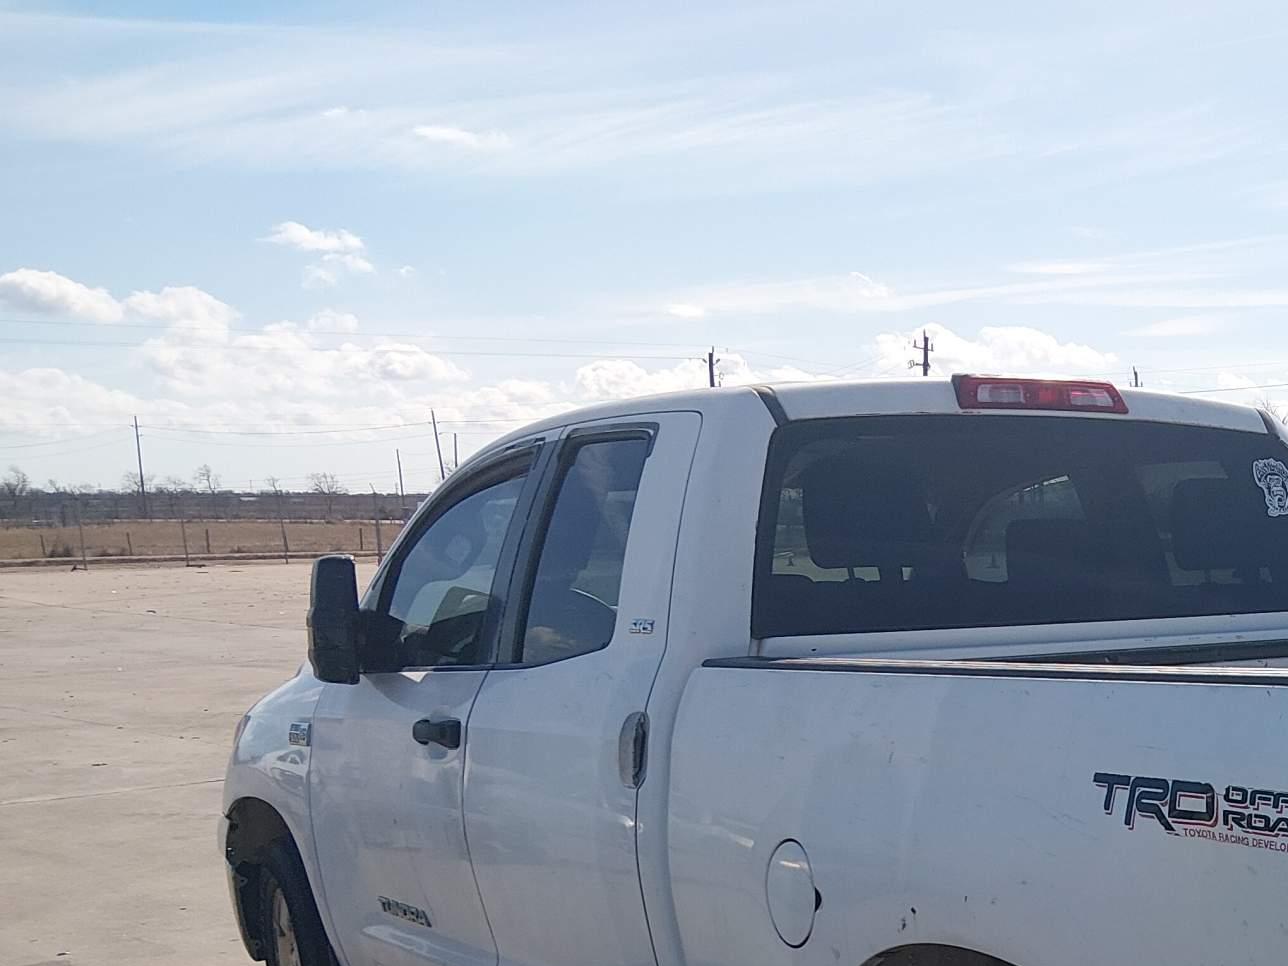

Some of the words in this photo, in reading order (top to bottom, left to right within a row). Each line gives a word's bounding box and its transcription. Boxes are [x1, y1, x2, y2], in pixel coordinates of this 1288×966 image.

[1093, 772, 1219, 836] TRD
[1183, 827, 1217, 842] TOYOTA
[1218, 832, 1250, 847] RACING
